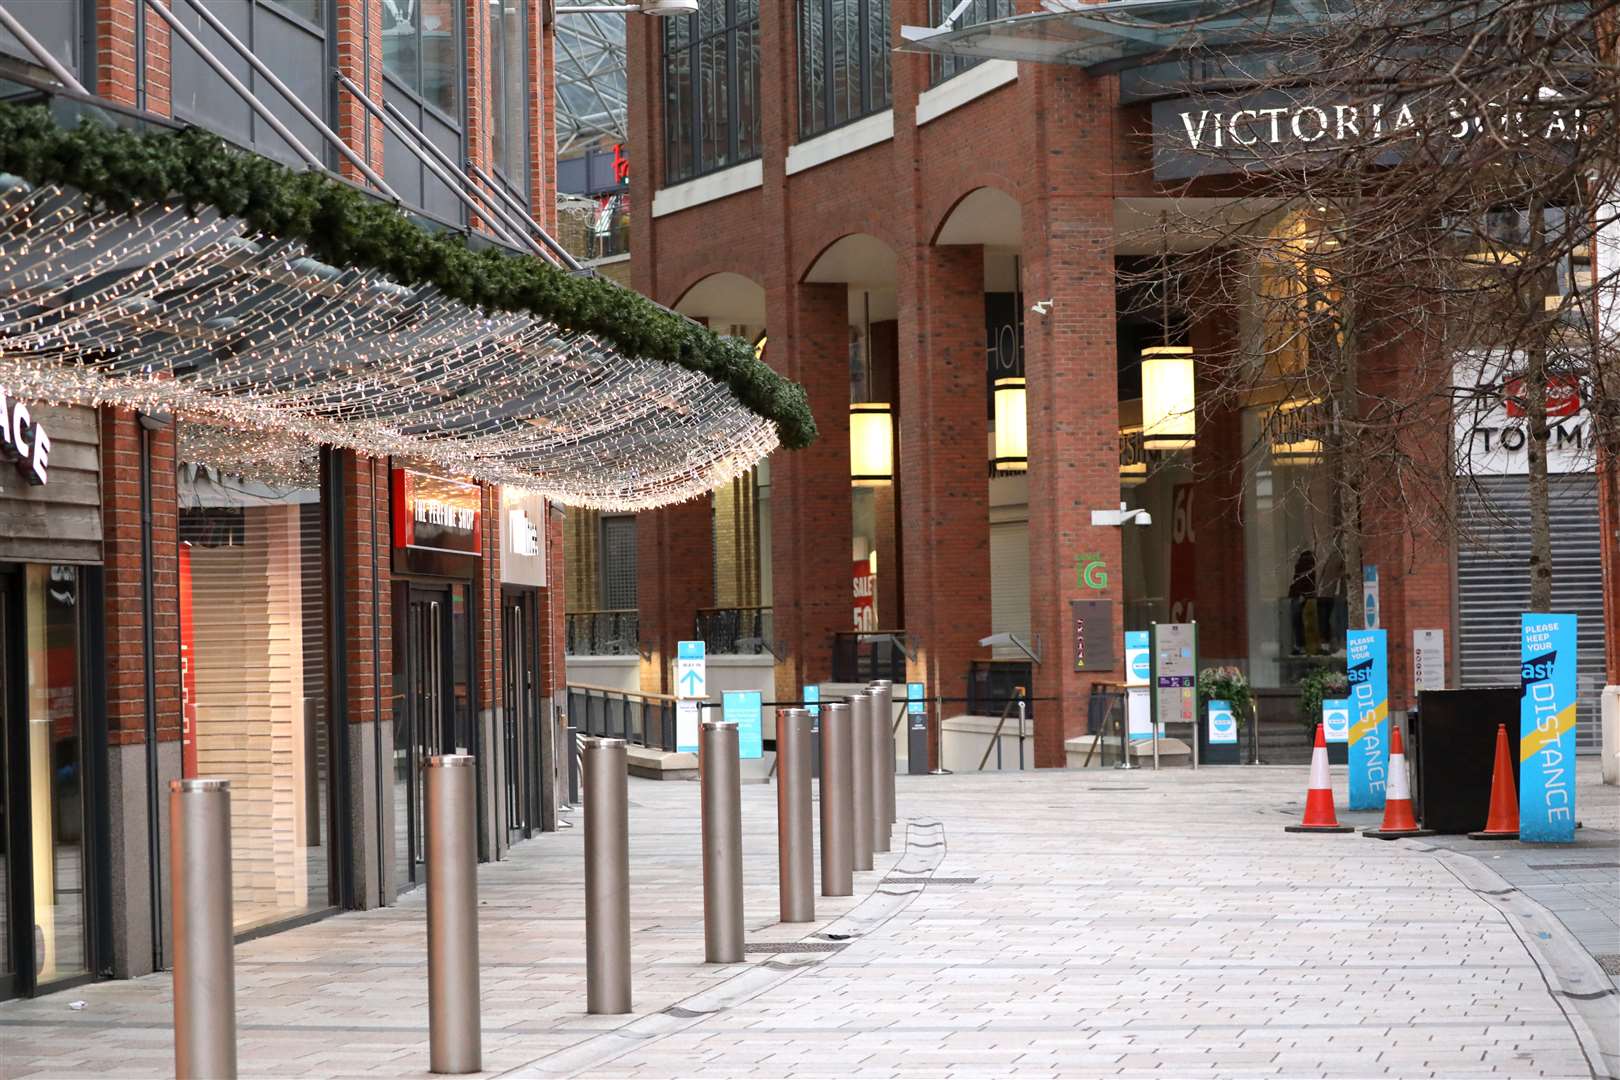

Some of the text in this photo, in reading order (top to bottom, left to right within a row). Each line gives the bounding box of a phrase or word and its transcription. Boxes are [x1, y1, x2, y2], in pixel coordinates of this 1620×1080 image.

[1179, 103, 1420, 149] VICTORIA
[853, 576, 873, 597] SALE
[1525, 623, 1559, 633] PLEASE
[1350, 635, 1375, 646] PLEASE
[1526, 633, 1550, 642] KEEP
[1350, 645, 1369, 654] KEEP
[1527, 642, 1552, 652] YOUR
[1351, 652, 1371, 660] YOUR
[1347, 667, 1372, 682] ast
[1521, 660, 1554, 680] ast
[1356, 683, 1387, 795] DISTANCE
[1532, 683, 1571, 824] DISTANCE
